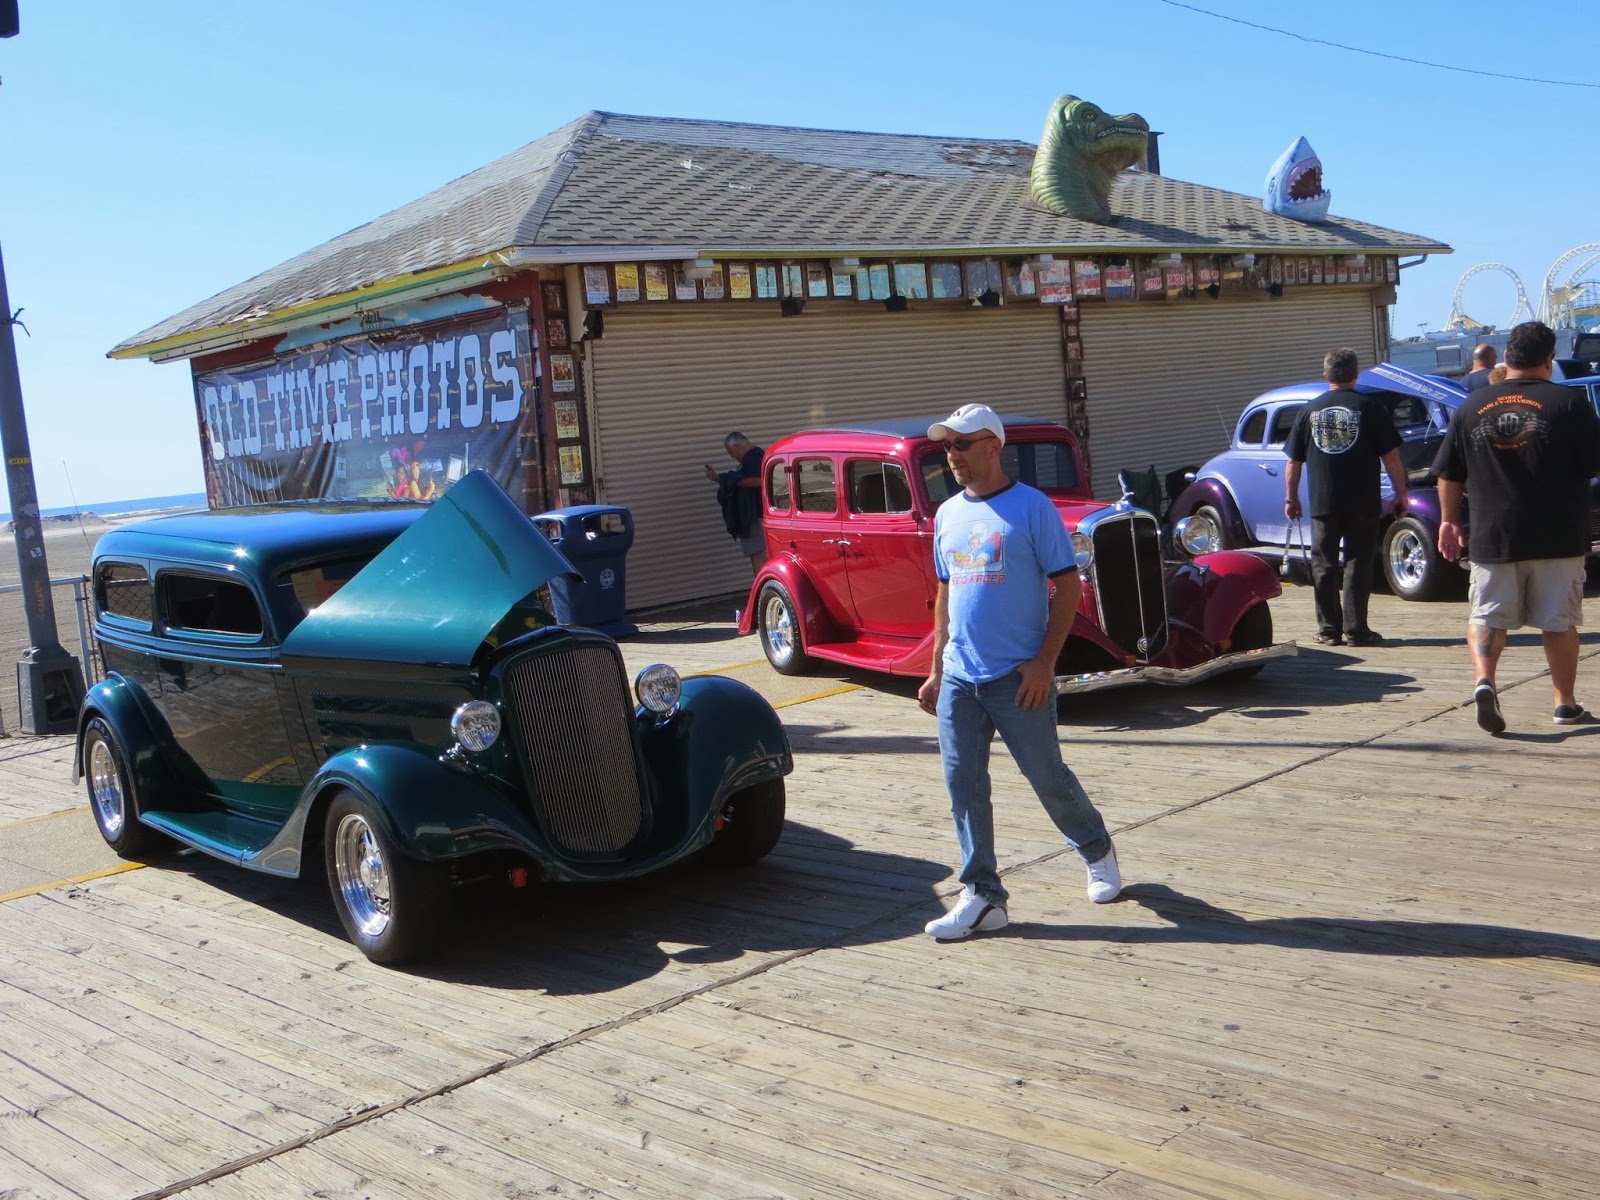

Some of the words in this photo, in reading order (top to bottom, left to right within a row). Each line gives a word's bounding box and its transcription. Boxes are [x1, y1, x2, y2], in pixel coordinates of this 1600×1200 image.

[205, 381, 261, 460] OLD
[267, 356, 353, 451] TIME
[358, 329, 524, 438] PHOTOS
[970, 574, 1006, 584] RACER
